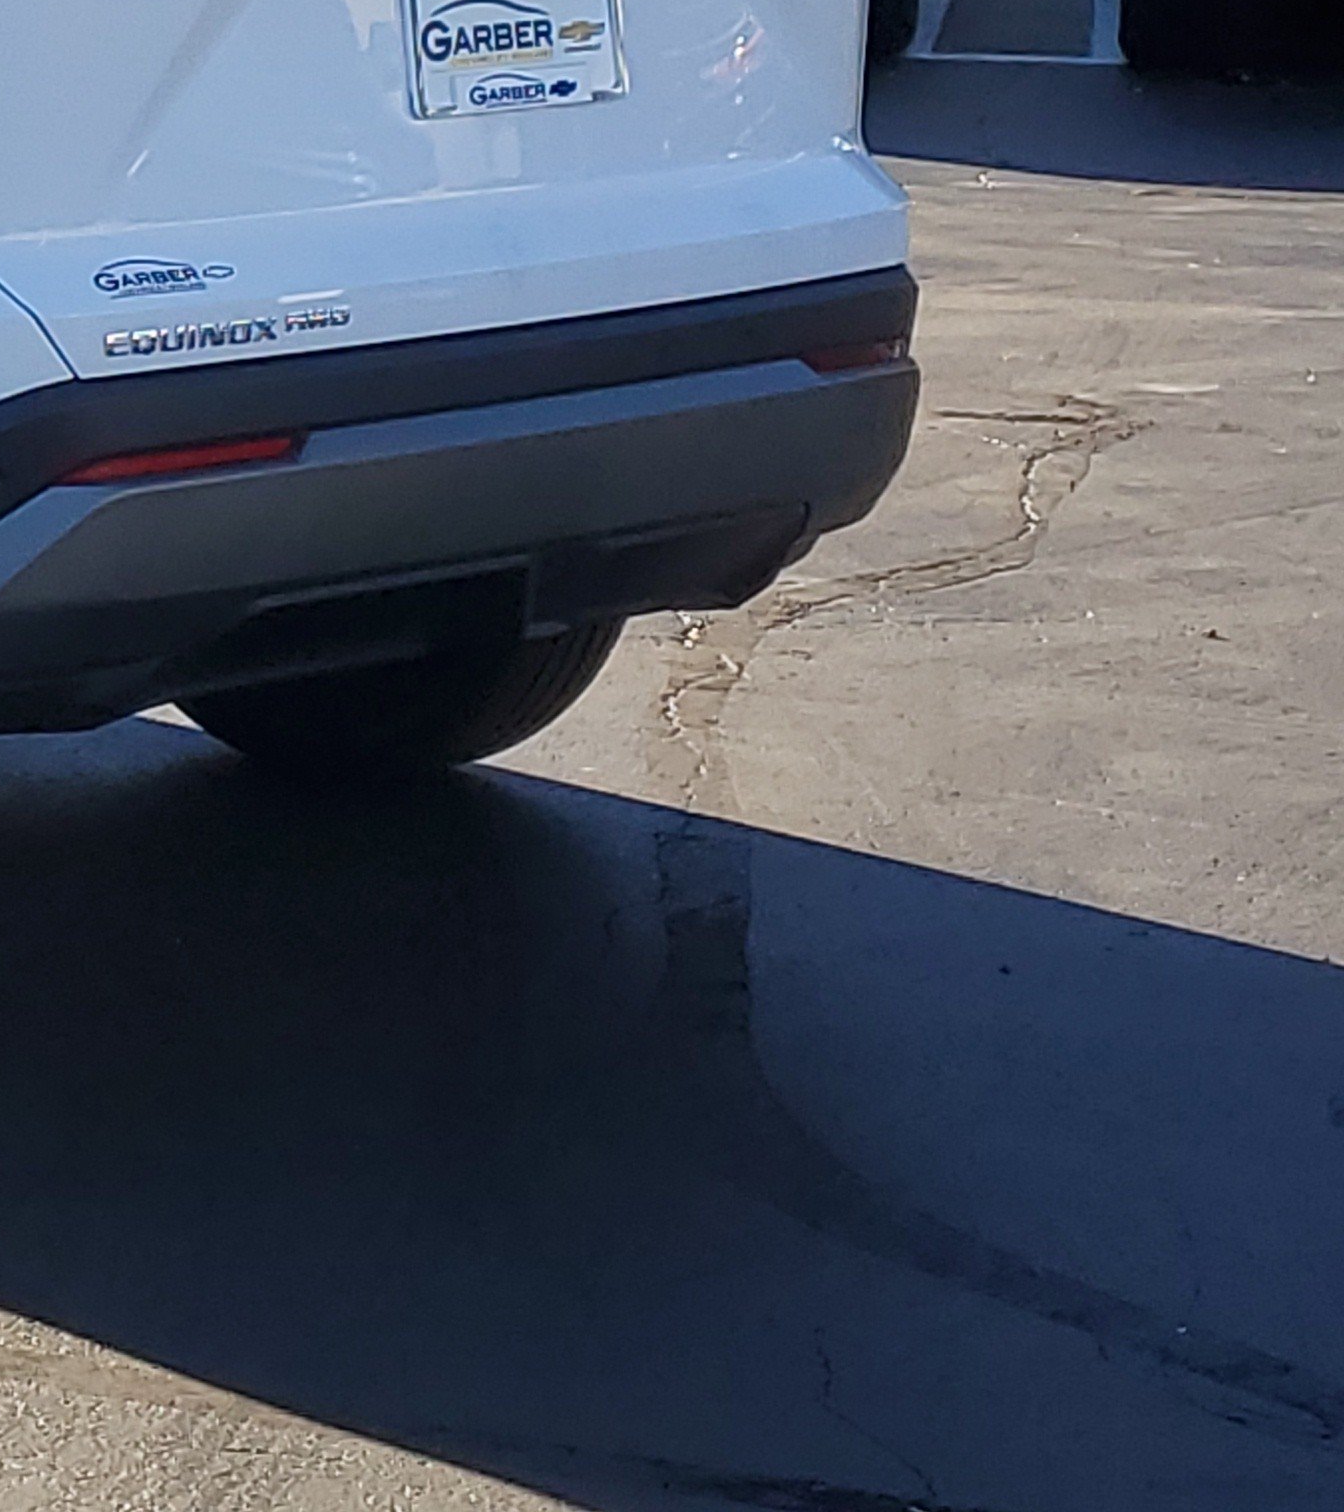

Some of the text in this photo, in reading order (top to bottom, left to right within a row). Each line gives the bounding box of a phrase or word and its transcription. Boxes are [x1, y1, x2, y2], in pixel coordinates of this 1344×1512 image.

[421, 19, 554, 62] GARBER
[468, 82, 547, 106] GARBER
[93, 264, 201, 292] GARBER
[103, 305, 352, 358] EQUINOX AWD
